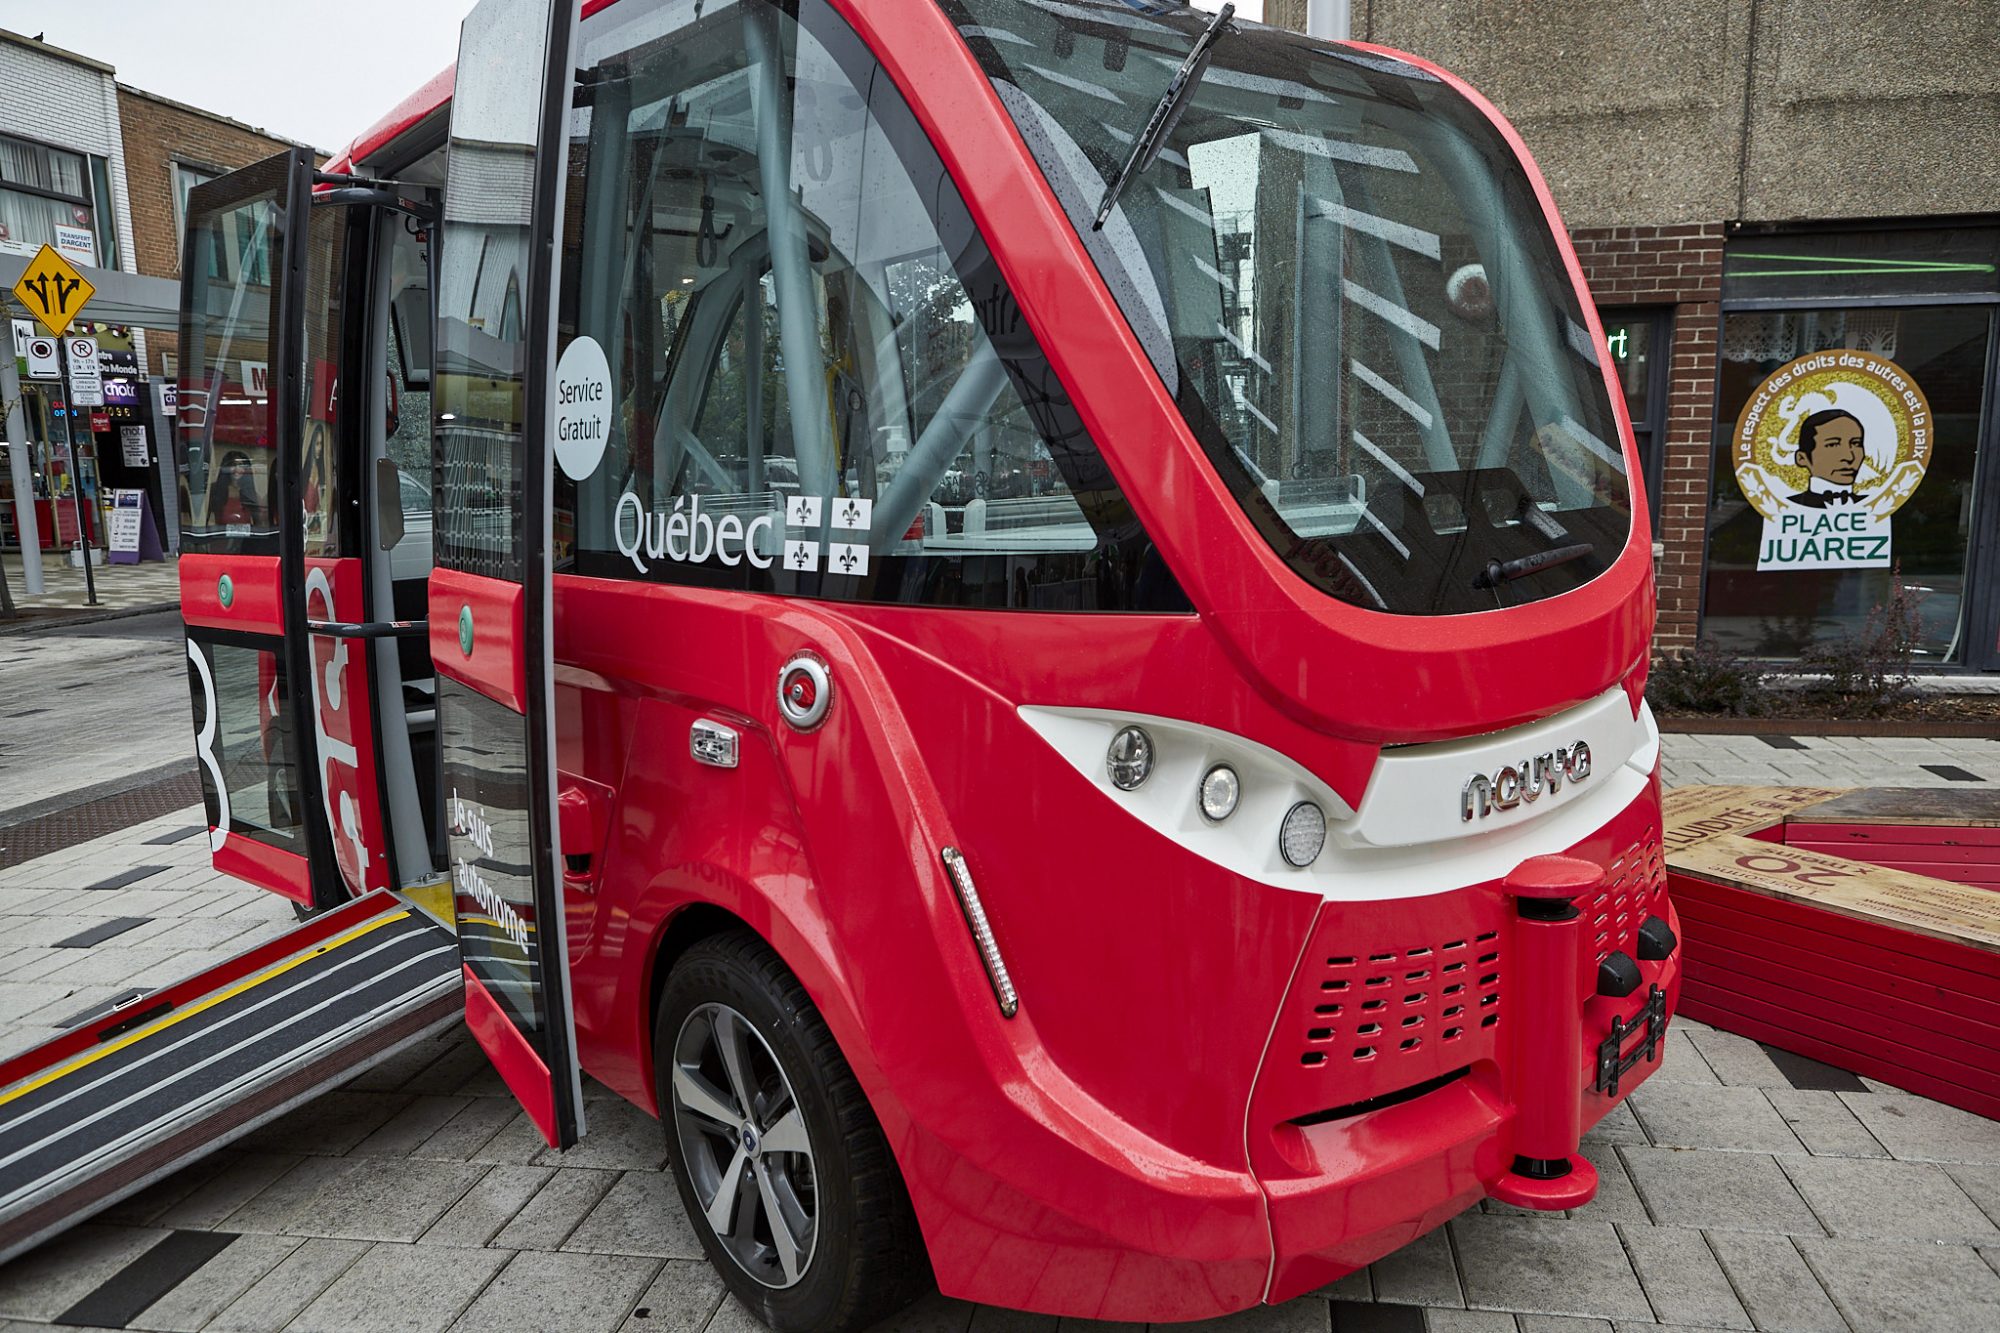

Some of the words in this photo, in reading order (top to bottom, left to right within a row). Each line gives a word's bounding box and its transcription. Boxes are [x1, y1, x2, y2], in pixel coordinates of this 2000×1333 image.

[60, 231, 91, 241] TRANSFERT
[99, 363, 110, 373] Du
[110, 363, 138, 375] Monde
[1792, 355, 1836, 377] droits
[1839, 353, 1865, 367] des
[1768, 372, 1792, 393] des
[1866, 360, 1907, 392] autres
[559, 379, 603, 404] Service
[1903, 390, 1921, 412] est
[54, 409, 78, 417] OPN
[1743, 392, 1771, 439] respect
[1912, 412, 1927, 427] la
[558, 416, 602, 442] Gratuit
[1738, 438, 1752, 461] Le
[1912, 428, 1928, 460] paix
[614, 492, 774, 574] Québec
[1782, 512, 1867, 534] PLACE
[1760, 531, 1889, 563] JUÁREZ
[453, 787, 466, 834] Je
[467, 807, 494, 858] suis
[1664, 808, 1772, 848] LUIDITÉ
[1708, 865, 1802, 891] personne
[458, 856, 529, 955] autonome
